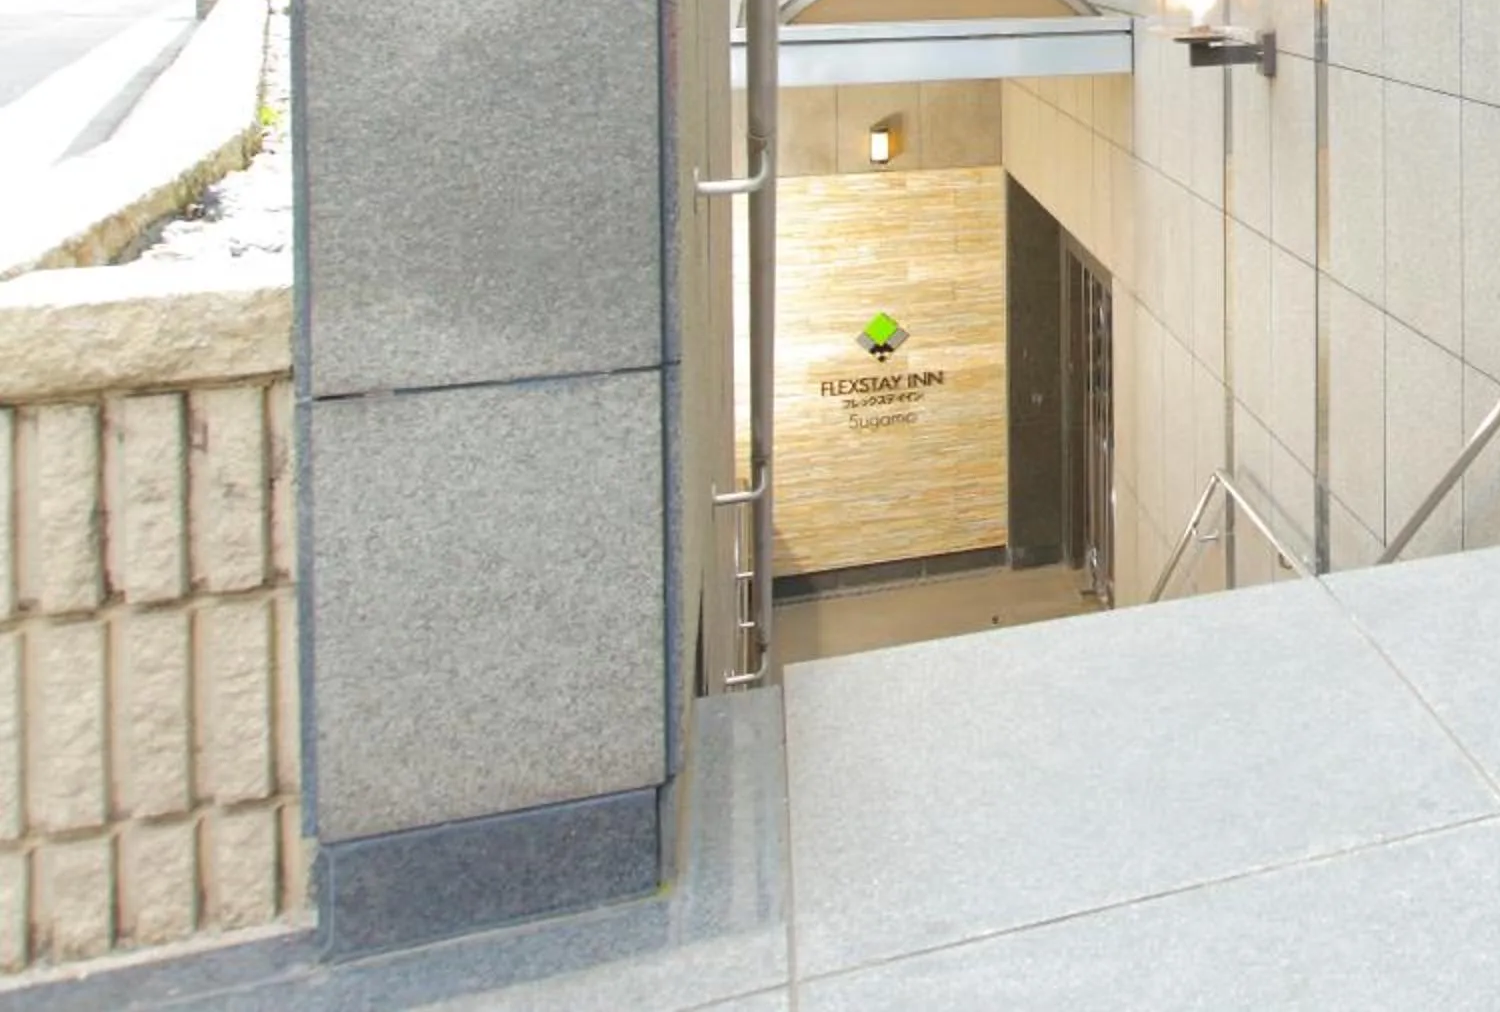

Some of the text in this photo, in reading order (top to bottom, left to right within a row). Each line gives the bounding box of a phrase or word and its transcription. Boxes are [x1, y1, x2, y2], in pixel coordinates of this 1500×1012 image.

[821, 371, 944, 396] FLEXSTAY INN
[849, 412, 918, 429] Sugamo
